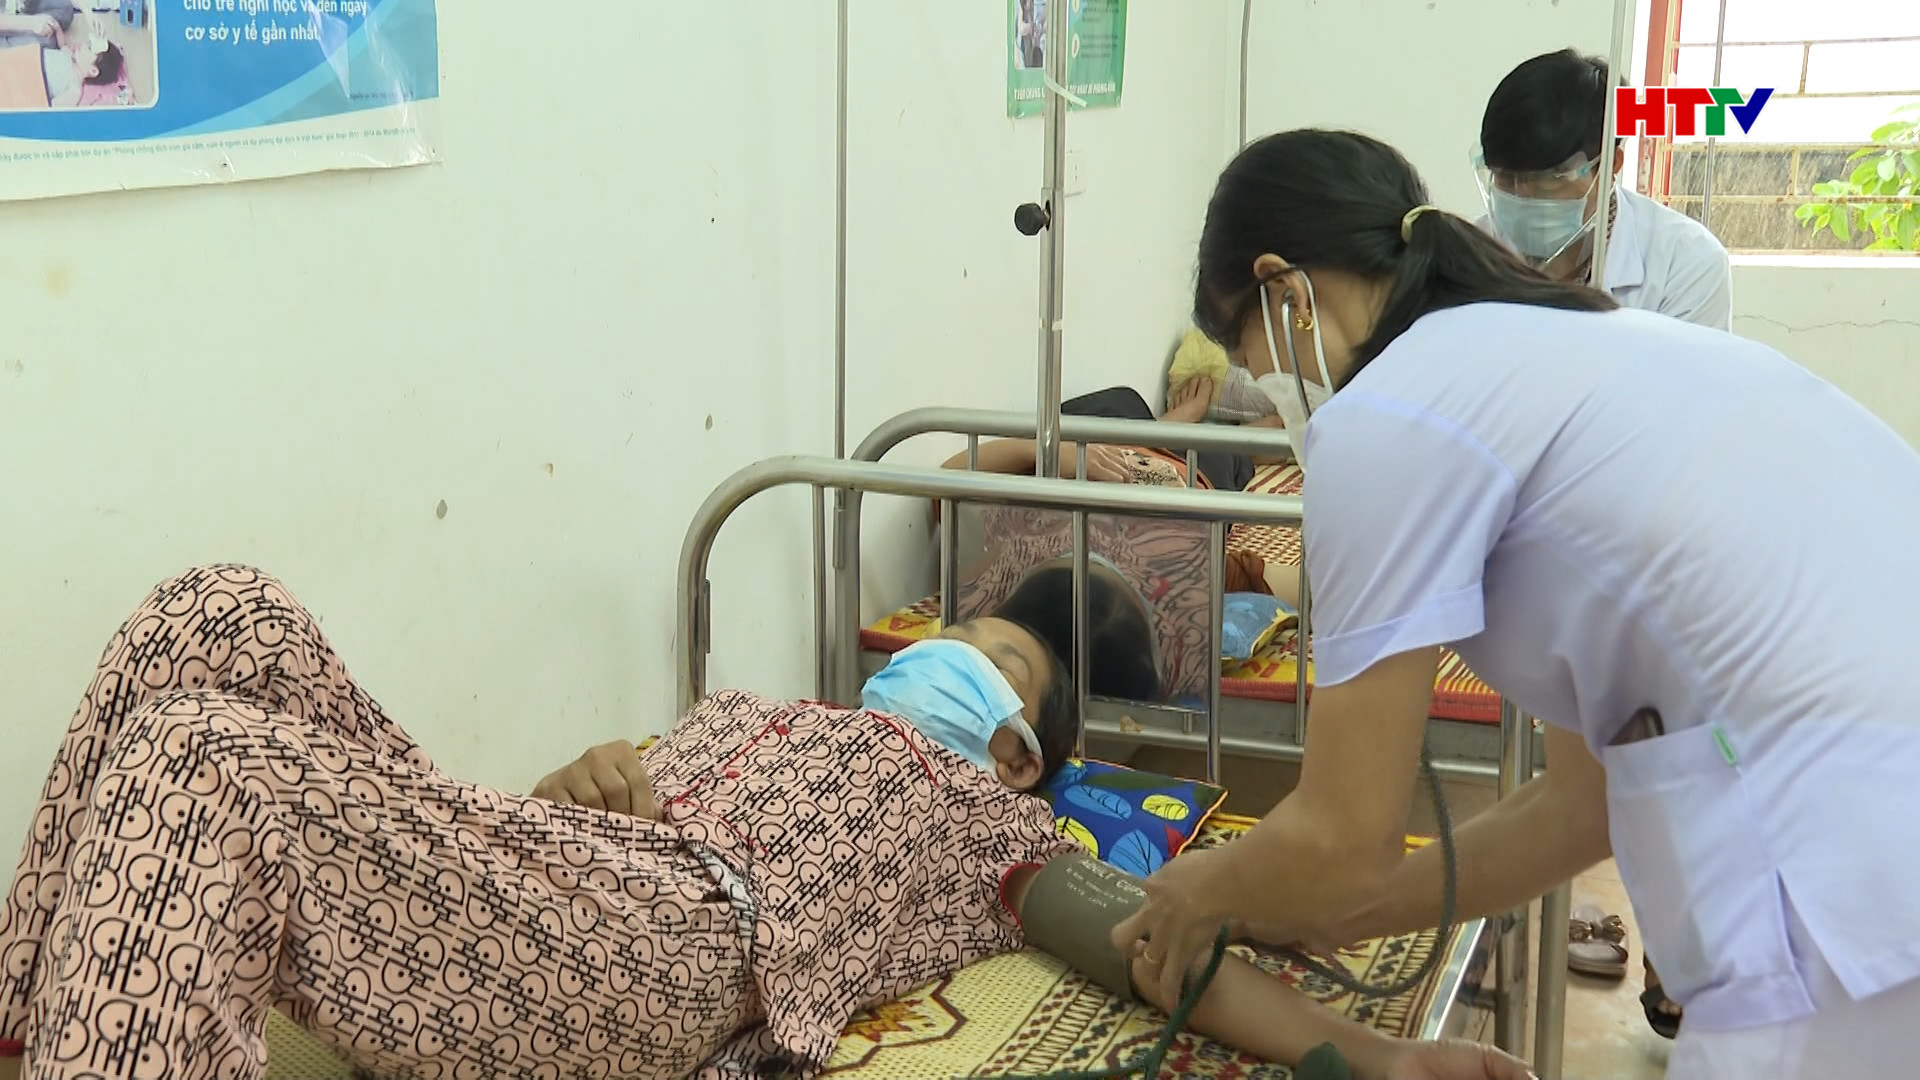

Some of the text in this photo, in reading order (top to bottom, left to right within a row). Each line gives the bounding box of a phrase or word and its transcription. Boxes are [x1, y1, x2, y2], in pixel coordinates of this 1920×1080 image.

[183, 0, 211, 10] cho
[273, 0, 297, 15] học
[185, 27, 205, 41] cơ
[209, 20, 229, 41] sở
[232, 27, 241, 46] y
[245, 19, 258, 41] tế
[262, 19, 287, 45] gần
